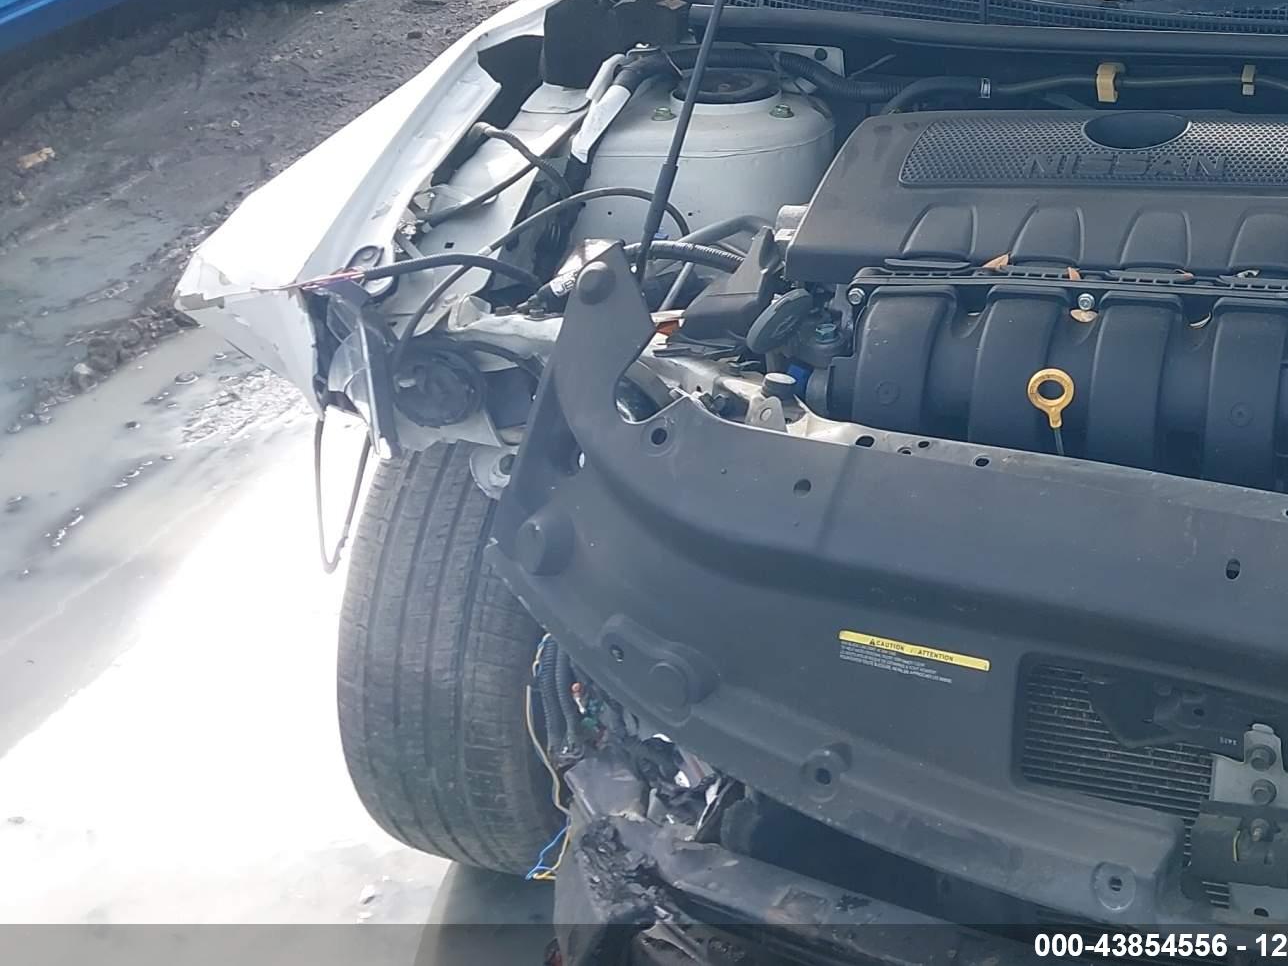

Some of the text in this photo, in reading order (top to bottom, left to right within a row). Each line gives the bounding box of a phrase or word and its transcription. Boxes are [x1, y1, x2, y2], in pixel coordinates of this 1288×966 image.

[1023, 153, 1226, 176] NISSAN
[876, 640, 904, 651] CAUTION
[917, 649, 954, 662] ATTENTION
